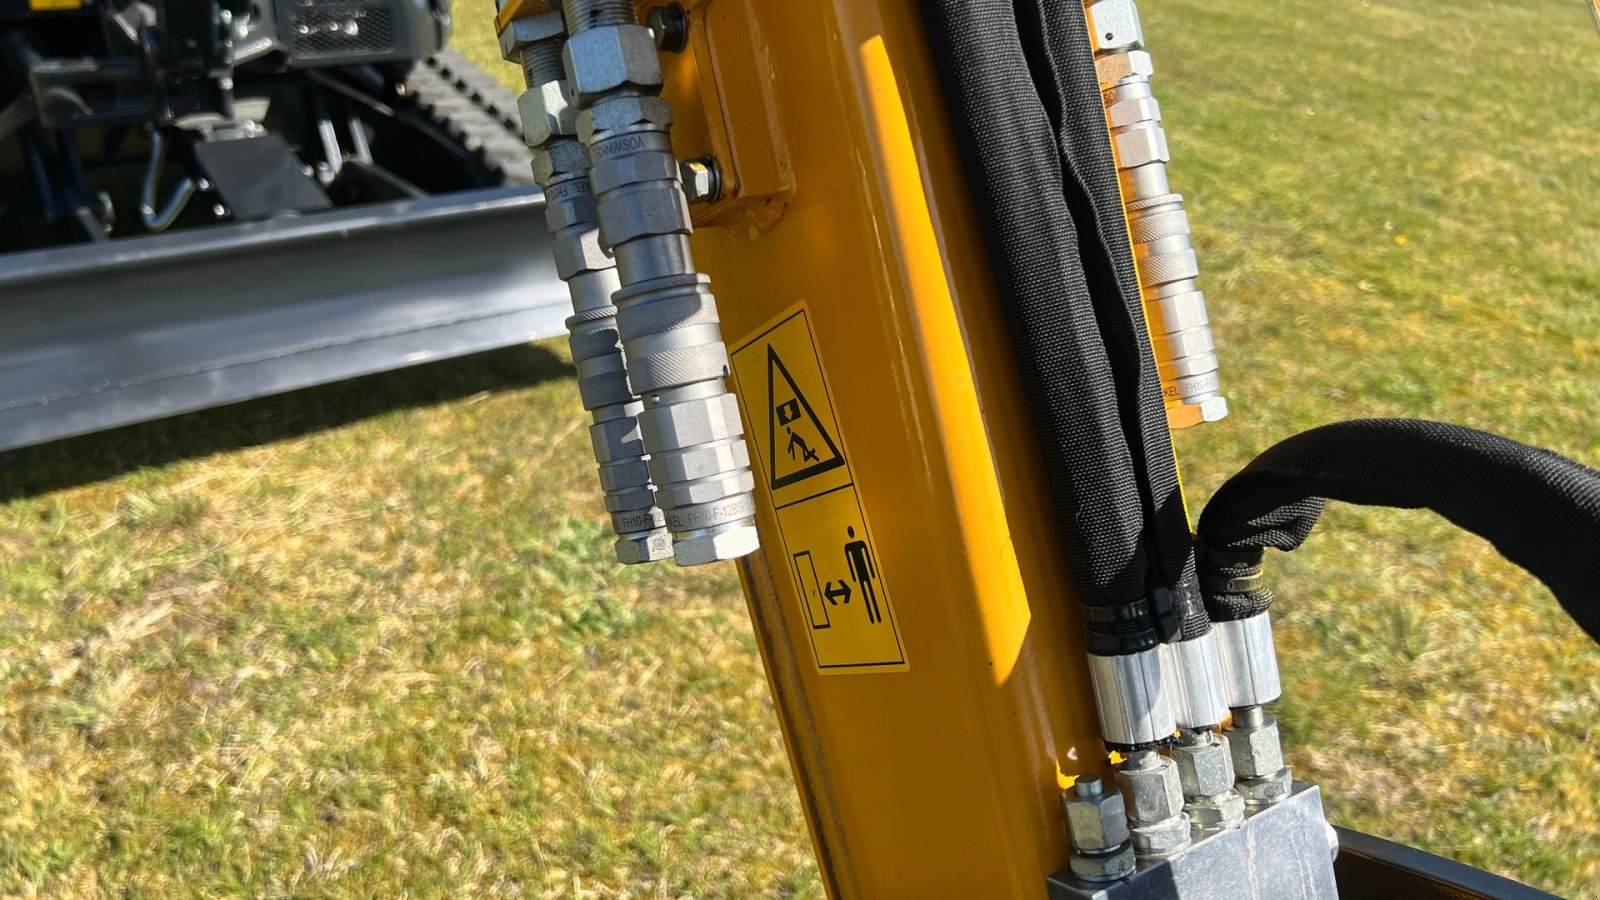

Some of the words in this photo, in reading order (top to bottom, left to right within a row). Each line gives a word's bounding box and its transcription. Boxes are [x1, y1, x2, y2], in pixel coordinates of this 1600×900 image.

[573, 181, 592, 193] KEL
[1164, 386, 1180, 398] KEL
[667, 515, 683, 528] KEL
